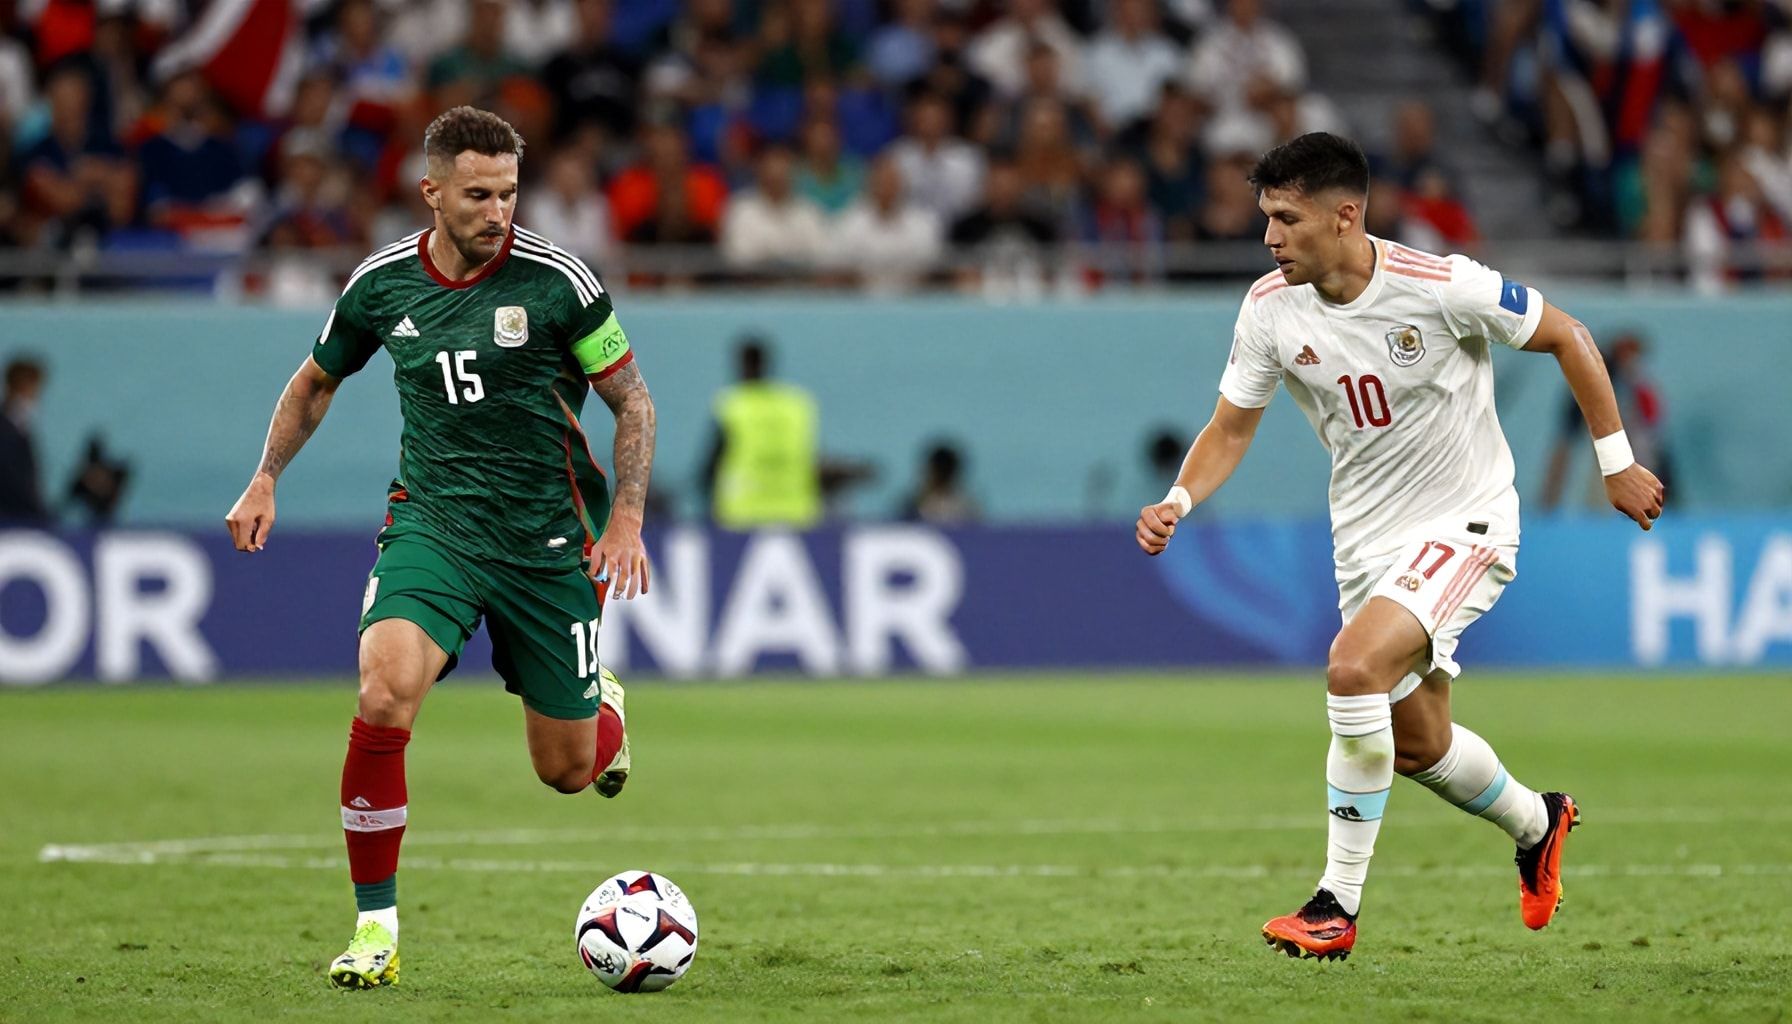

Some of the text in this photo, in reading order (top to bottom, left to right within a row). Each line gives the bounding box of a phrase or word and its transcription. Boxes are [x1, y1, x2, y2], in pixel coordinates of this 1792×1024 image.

[435, 350, 486, 405] 15
[1337, 374, 1392, 429] 10
[0, 531, 216, 680] OR
[600, 526, 971, 675] NAR
[1629, 535, 1792, 665] HA
